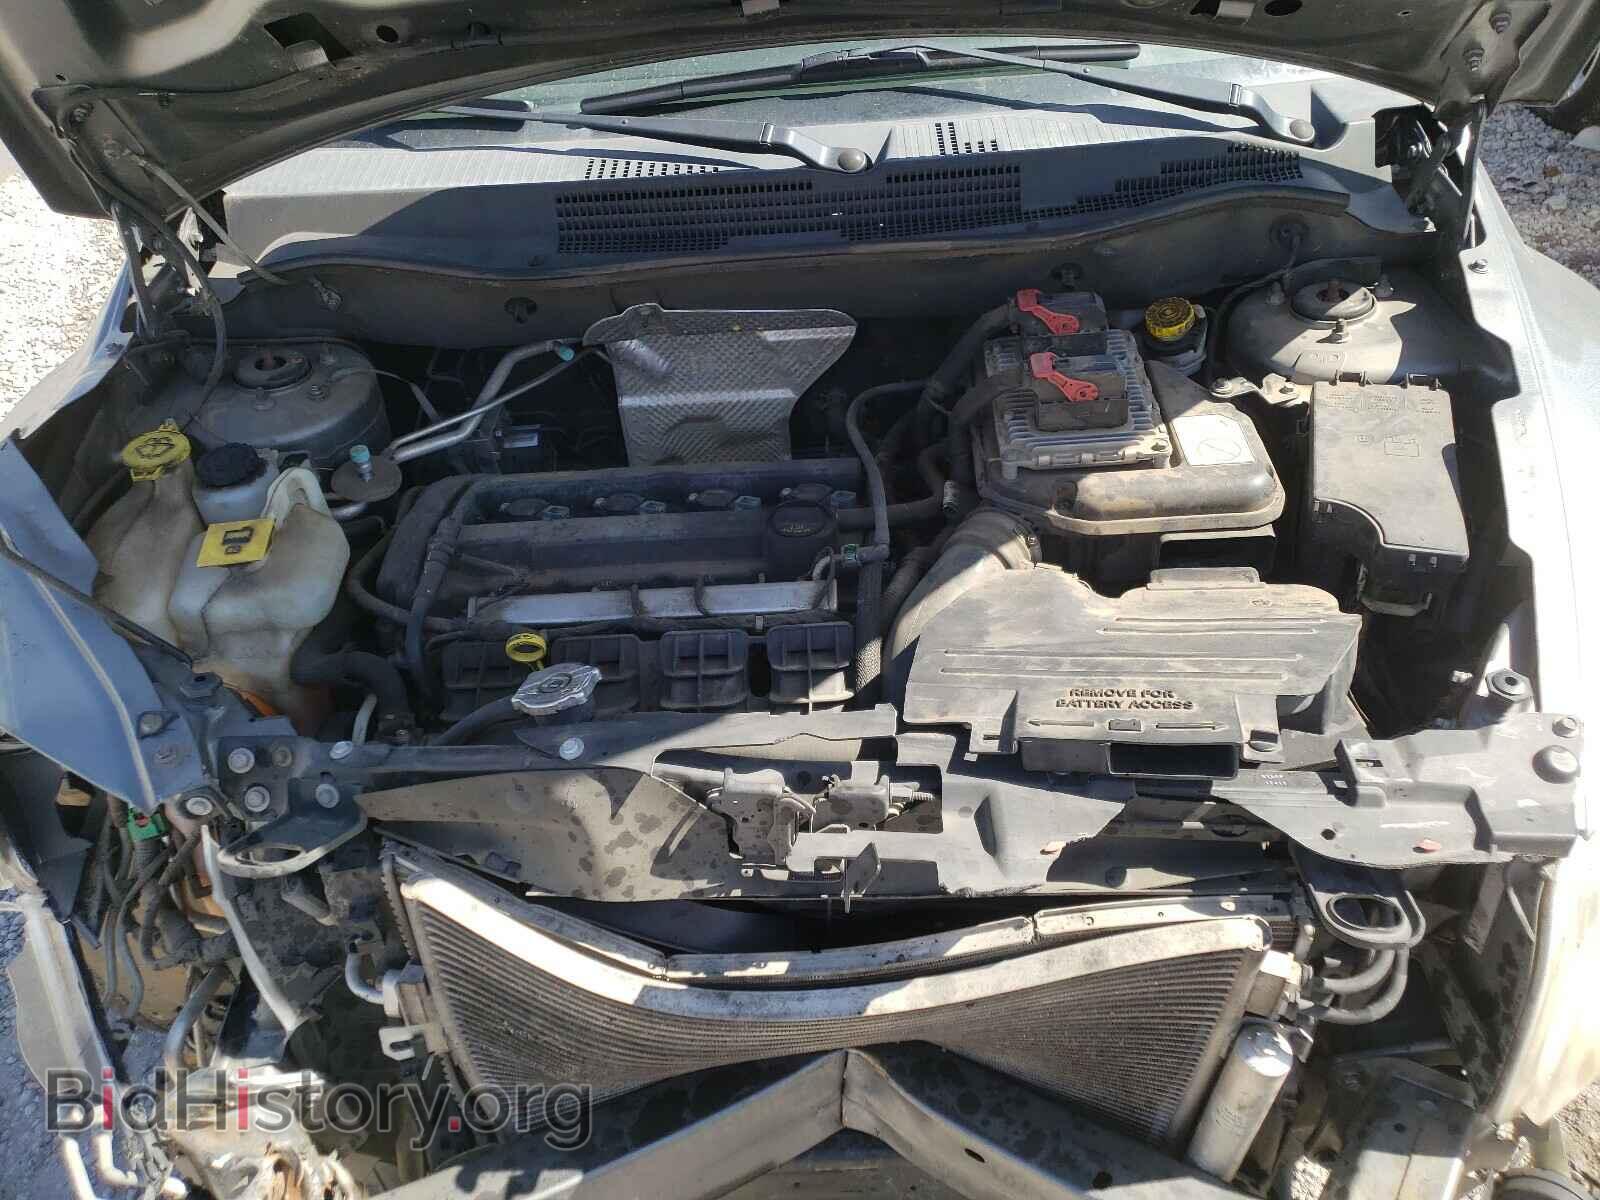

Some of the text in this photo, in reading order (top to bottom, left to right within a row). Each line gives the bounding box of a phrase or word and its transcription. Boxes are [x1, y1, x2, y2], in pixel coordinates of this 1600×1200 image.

[1070, 688, 1175, 698] REMOVE FOR
[1056, 699, 1194, 710] BATTERY ACCESS
